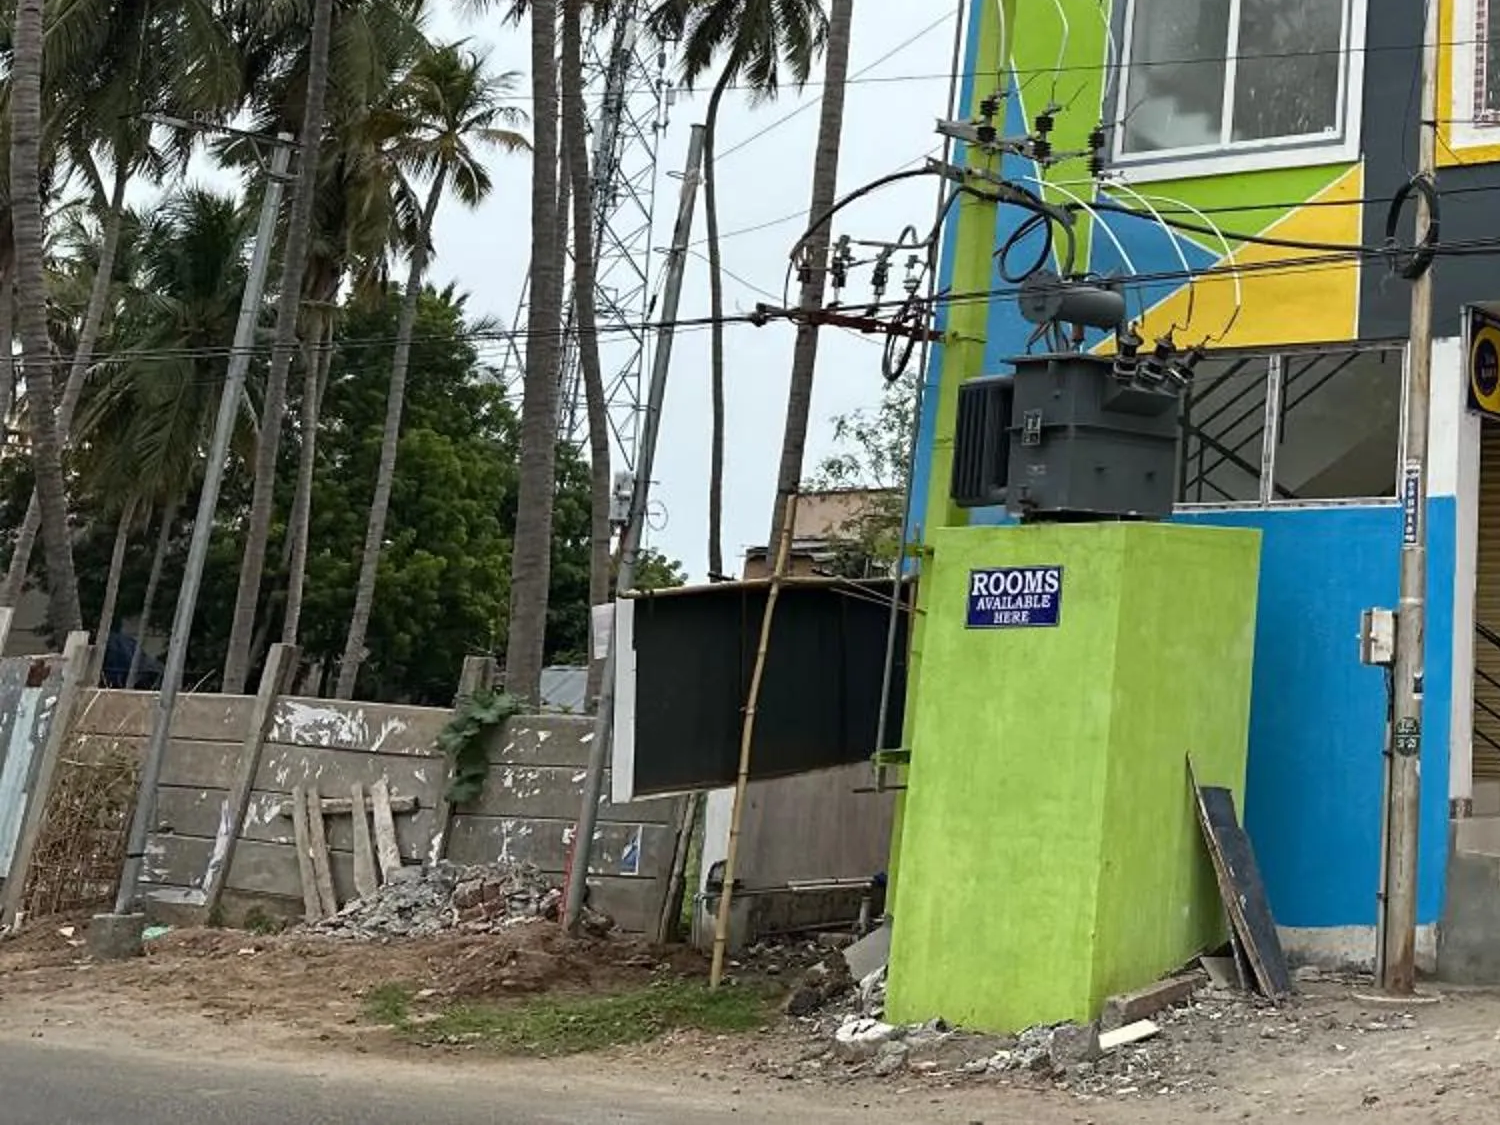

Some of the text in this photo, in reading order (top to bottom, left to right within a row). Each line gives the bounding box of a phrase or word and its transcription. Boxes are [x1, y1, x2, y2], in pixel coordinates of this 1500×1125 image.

[972, 569, 1059, 595] ROOMS
[976, 595, 1051, 611] AVAILABLE
[993, 610, 1031, 624] HERE
